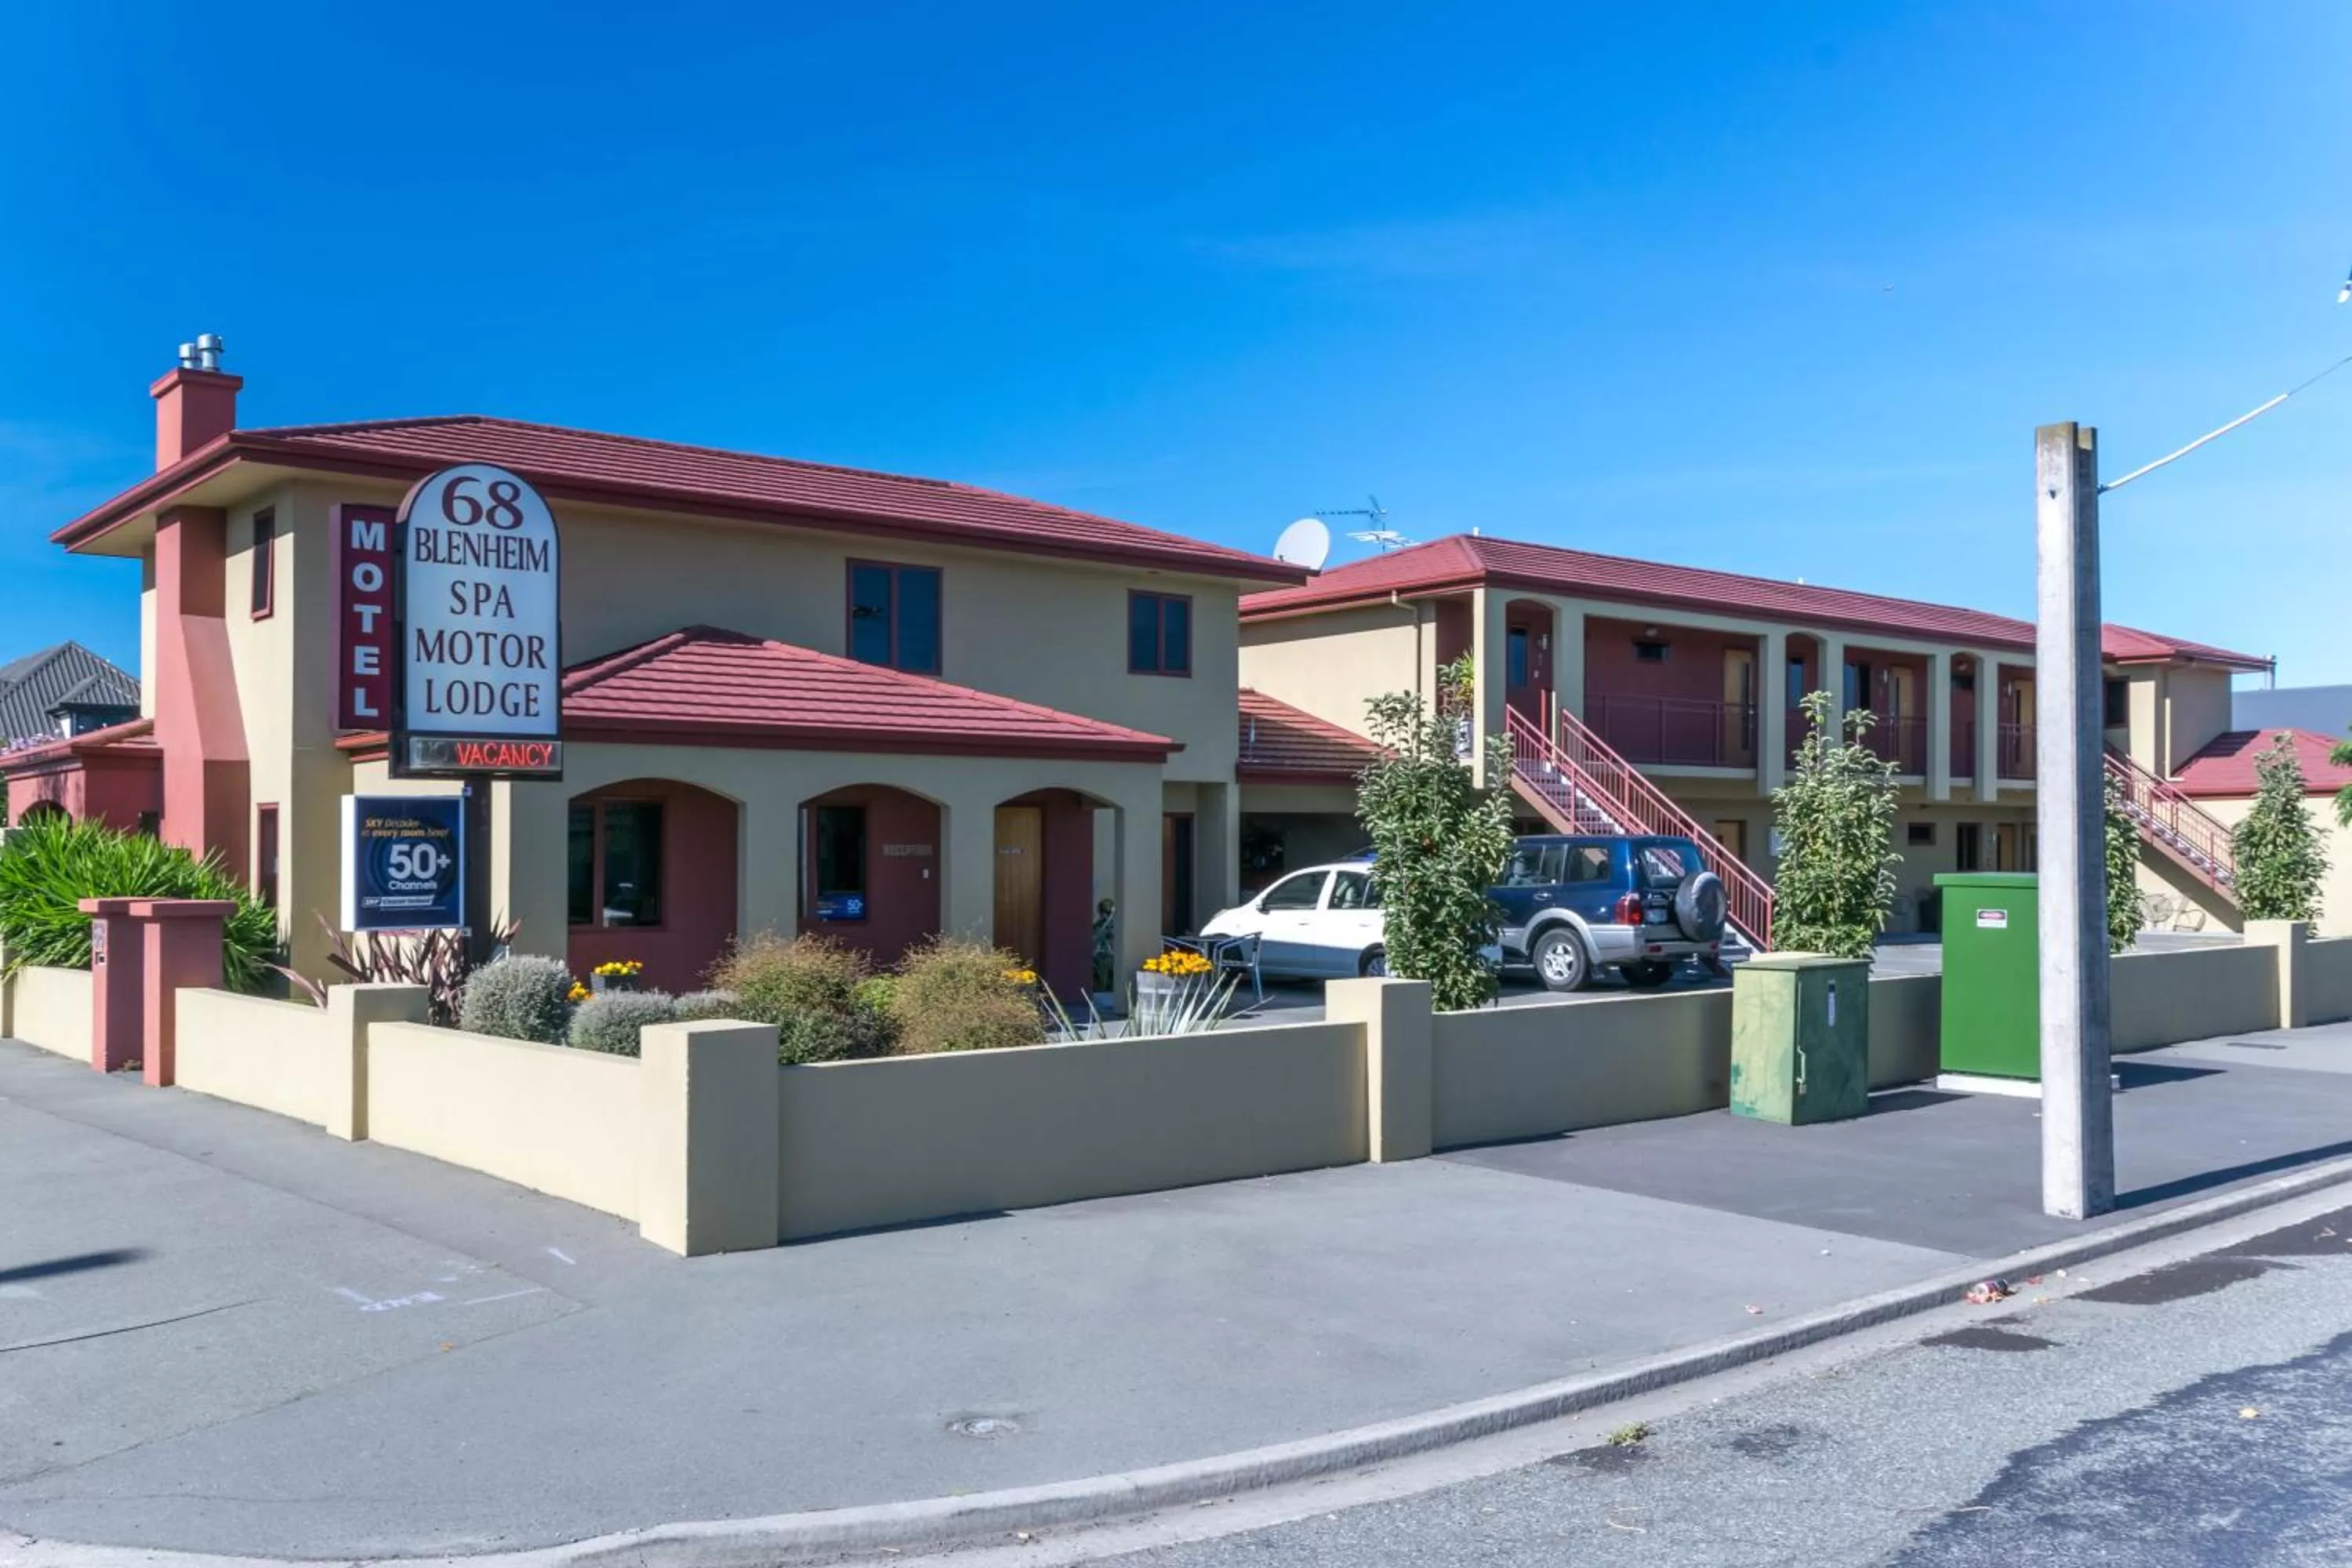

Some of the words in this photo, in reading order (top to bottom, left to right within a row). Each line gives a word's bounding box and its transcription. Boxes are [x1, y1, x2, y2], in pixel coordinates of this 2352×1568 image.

[441, 476, 524, 531] 68
[414, 527, 550, 574] BLENHEIM
[350, 520, 386, 717] MOTEL
[449, 579, 515, 619] SPA
[416, 628, 547, 670] MOTOR
[425, 678, 540, 717] LODGE
[457, 741, 554, 767] VACANCY
[372, 829, 399, 839] every
[400, 828, 426, 838] room
[388, 843, 452, 880] 50+
[388, 880, 438, 890] Channels
